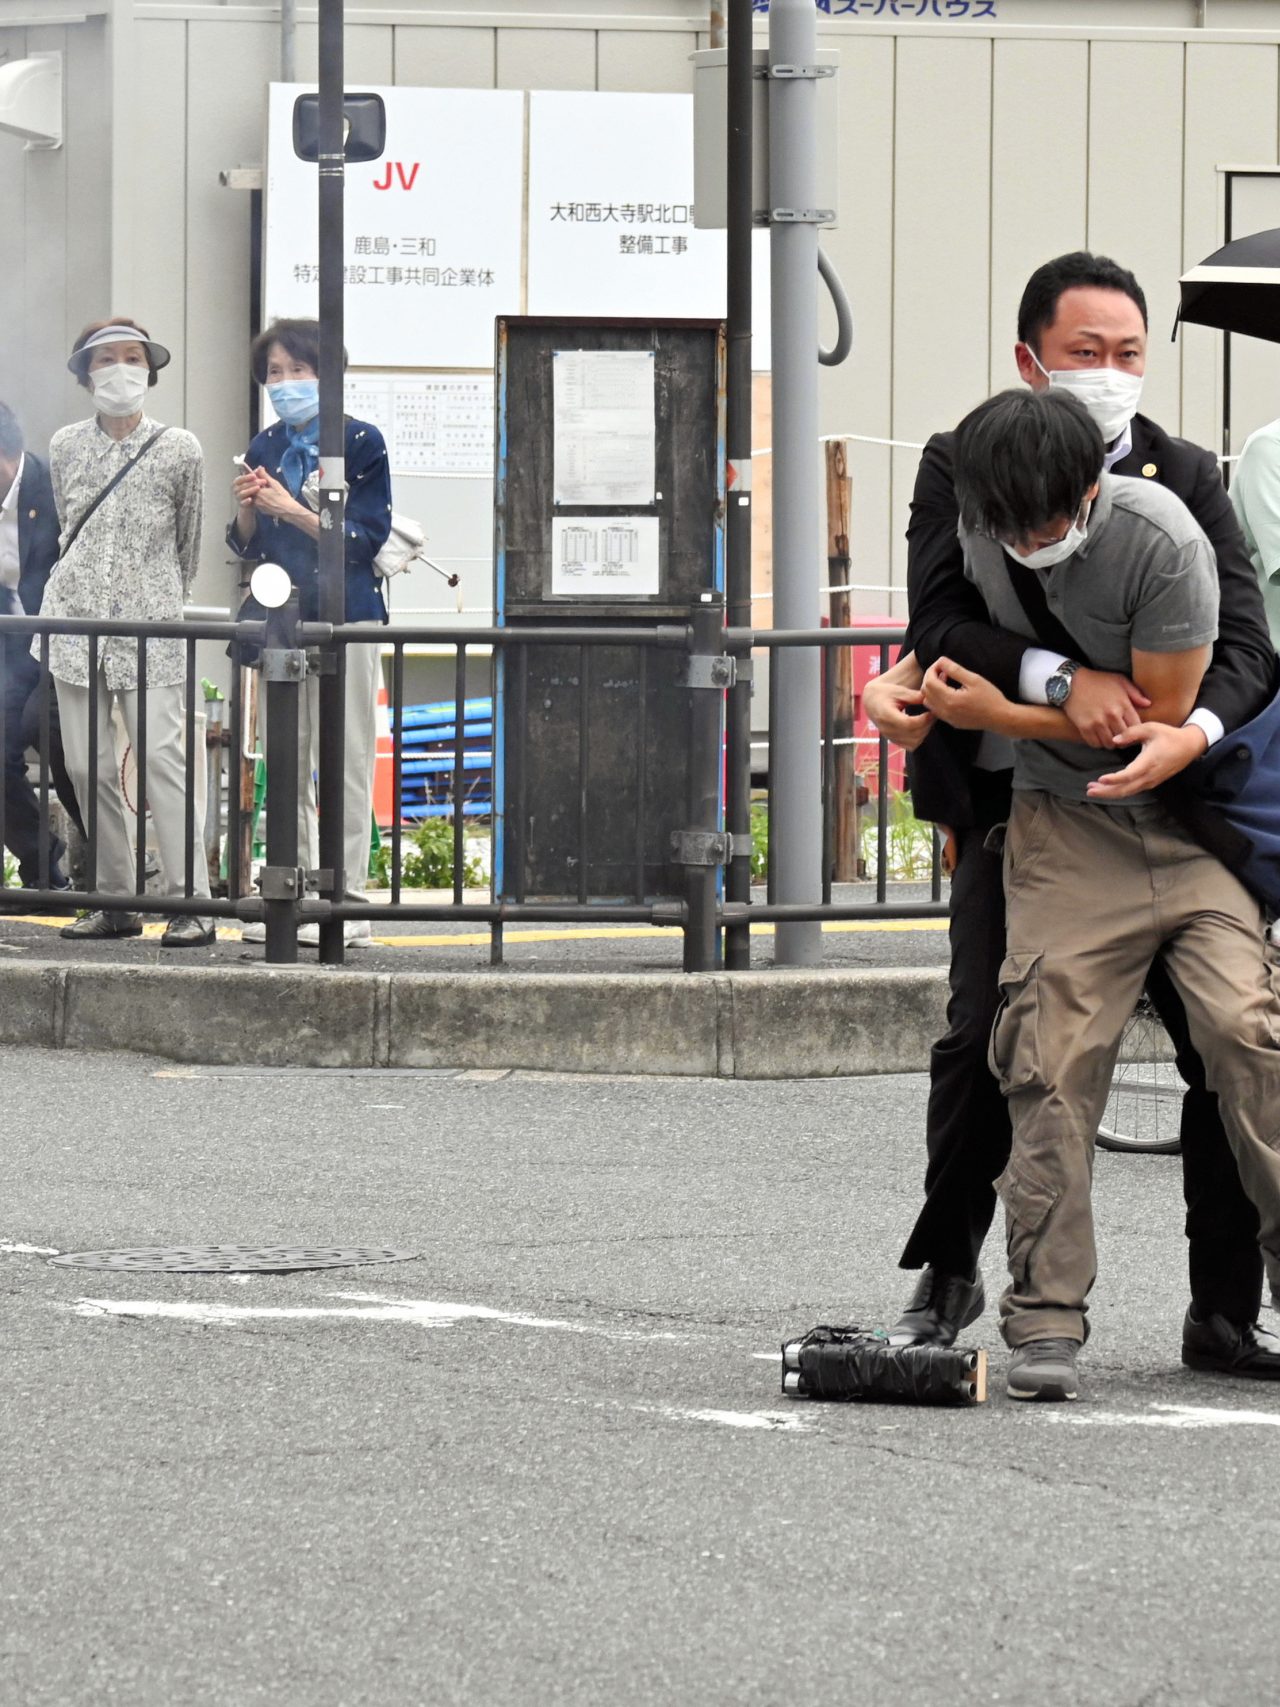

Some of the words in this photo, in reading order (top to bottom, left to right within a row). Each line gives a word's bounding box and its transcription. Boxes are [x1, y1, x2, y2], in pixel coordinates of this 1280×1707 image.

[373, 162, 420, 190] JV
[550, 202, 695, 223] 大和西大寺駅北口
[354, 236, 436, 256] 鹿島・三和
[619, 235, 688, 255] 整備工事
[293, 264, 495, 287] 特設工事共同企業体
